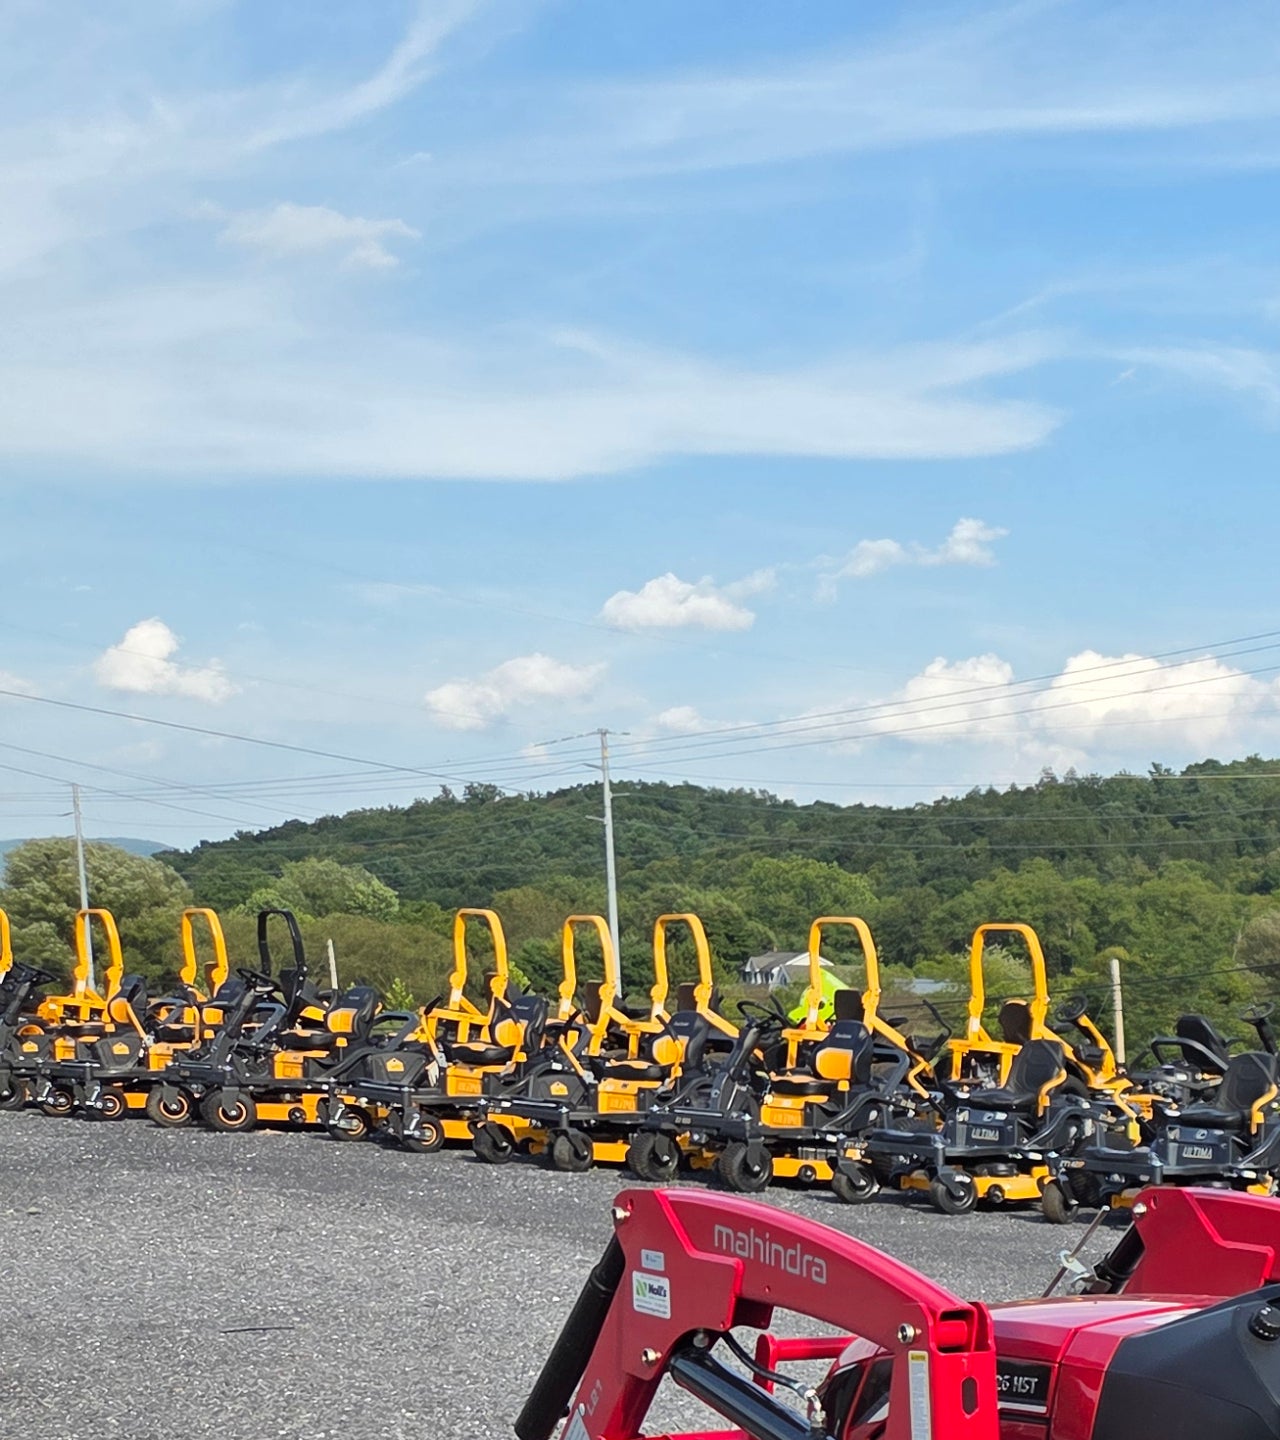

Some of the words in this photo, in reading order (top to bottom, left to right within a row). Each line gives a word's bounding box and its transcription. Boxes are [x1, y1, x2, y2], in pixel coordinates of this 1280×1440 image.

[1182, 1146, 1213, 1160] ULTIMA
[714, 1224, 827, 1284] mahindra
[1013, 1376, 1038, 1394] HST
